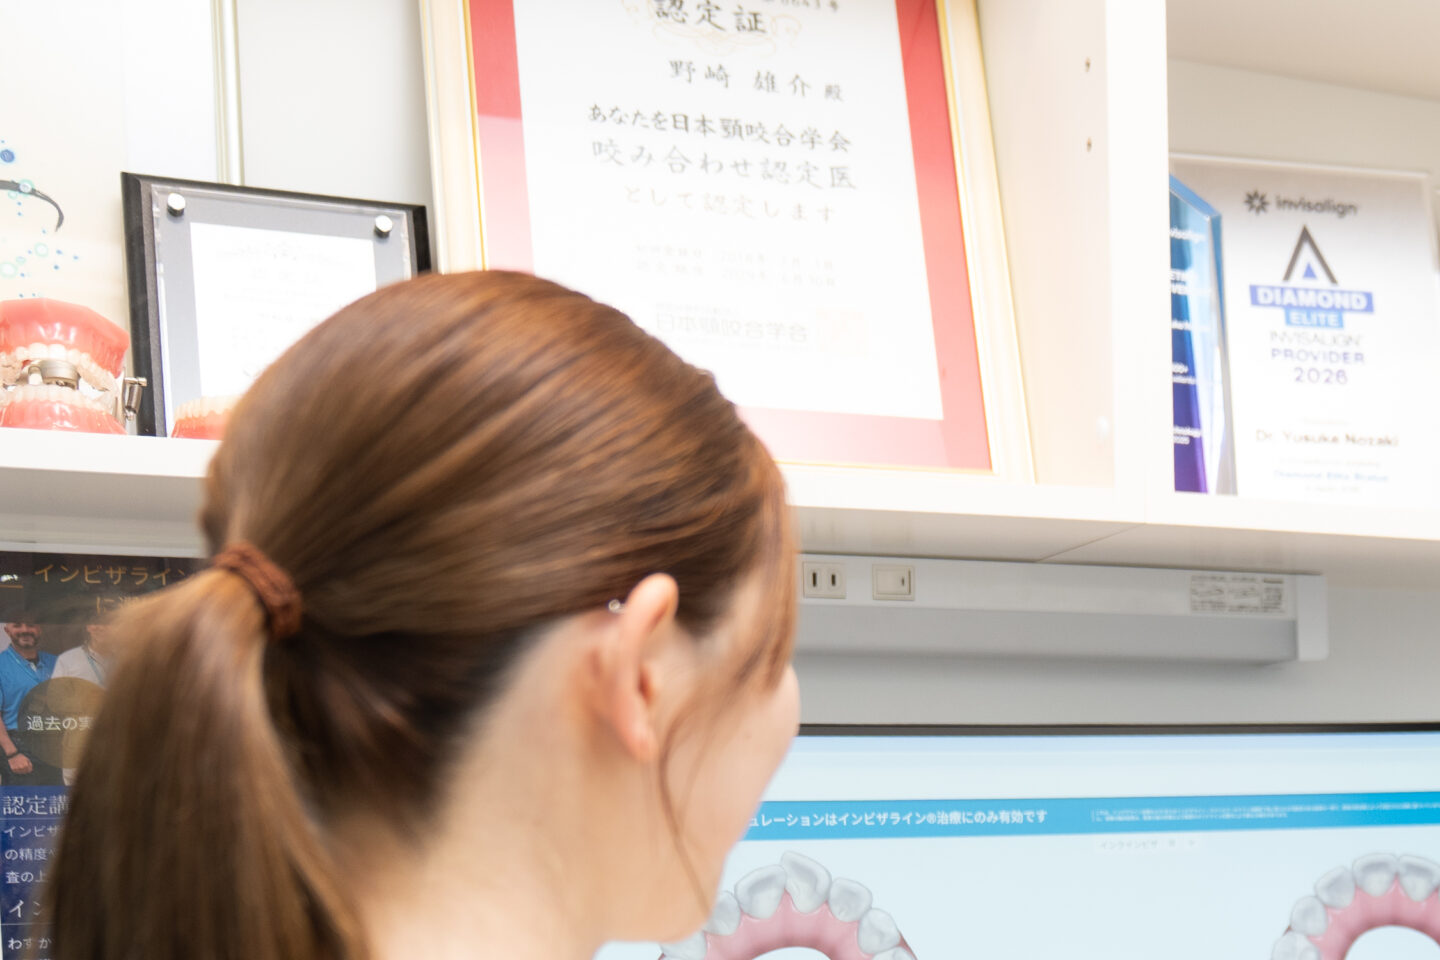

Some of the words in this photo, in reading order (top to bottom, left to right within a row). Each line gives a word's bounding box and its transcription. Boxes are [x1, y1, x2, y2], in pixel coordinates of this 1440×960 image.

[654, 0, 768, 35] 認定証
[668, 59, 731, 90] 野崎
[752, 69, 813, 99] 雄介
[587, 103, 853, 155] あなたを日本顎咬合学会
[592, 139, 857, 191] 咬み合わせ認定医
[622, 184, 837, 224] として認定します
[1275, 194, 1358, 218] invisalign
[1256, 287, 1368, 312] DIAMOND
[1290, 311, 1341, 328] ELITE
[1270, 347, 1366, 364] PROVIDER
